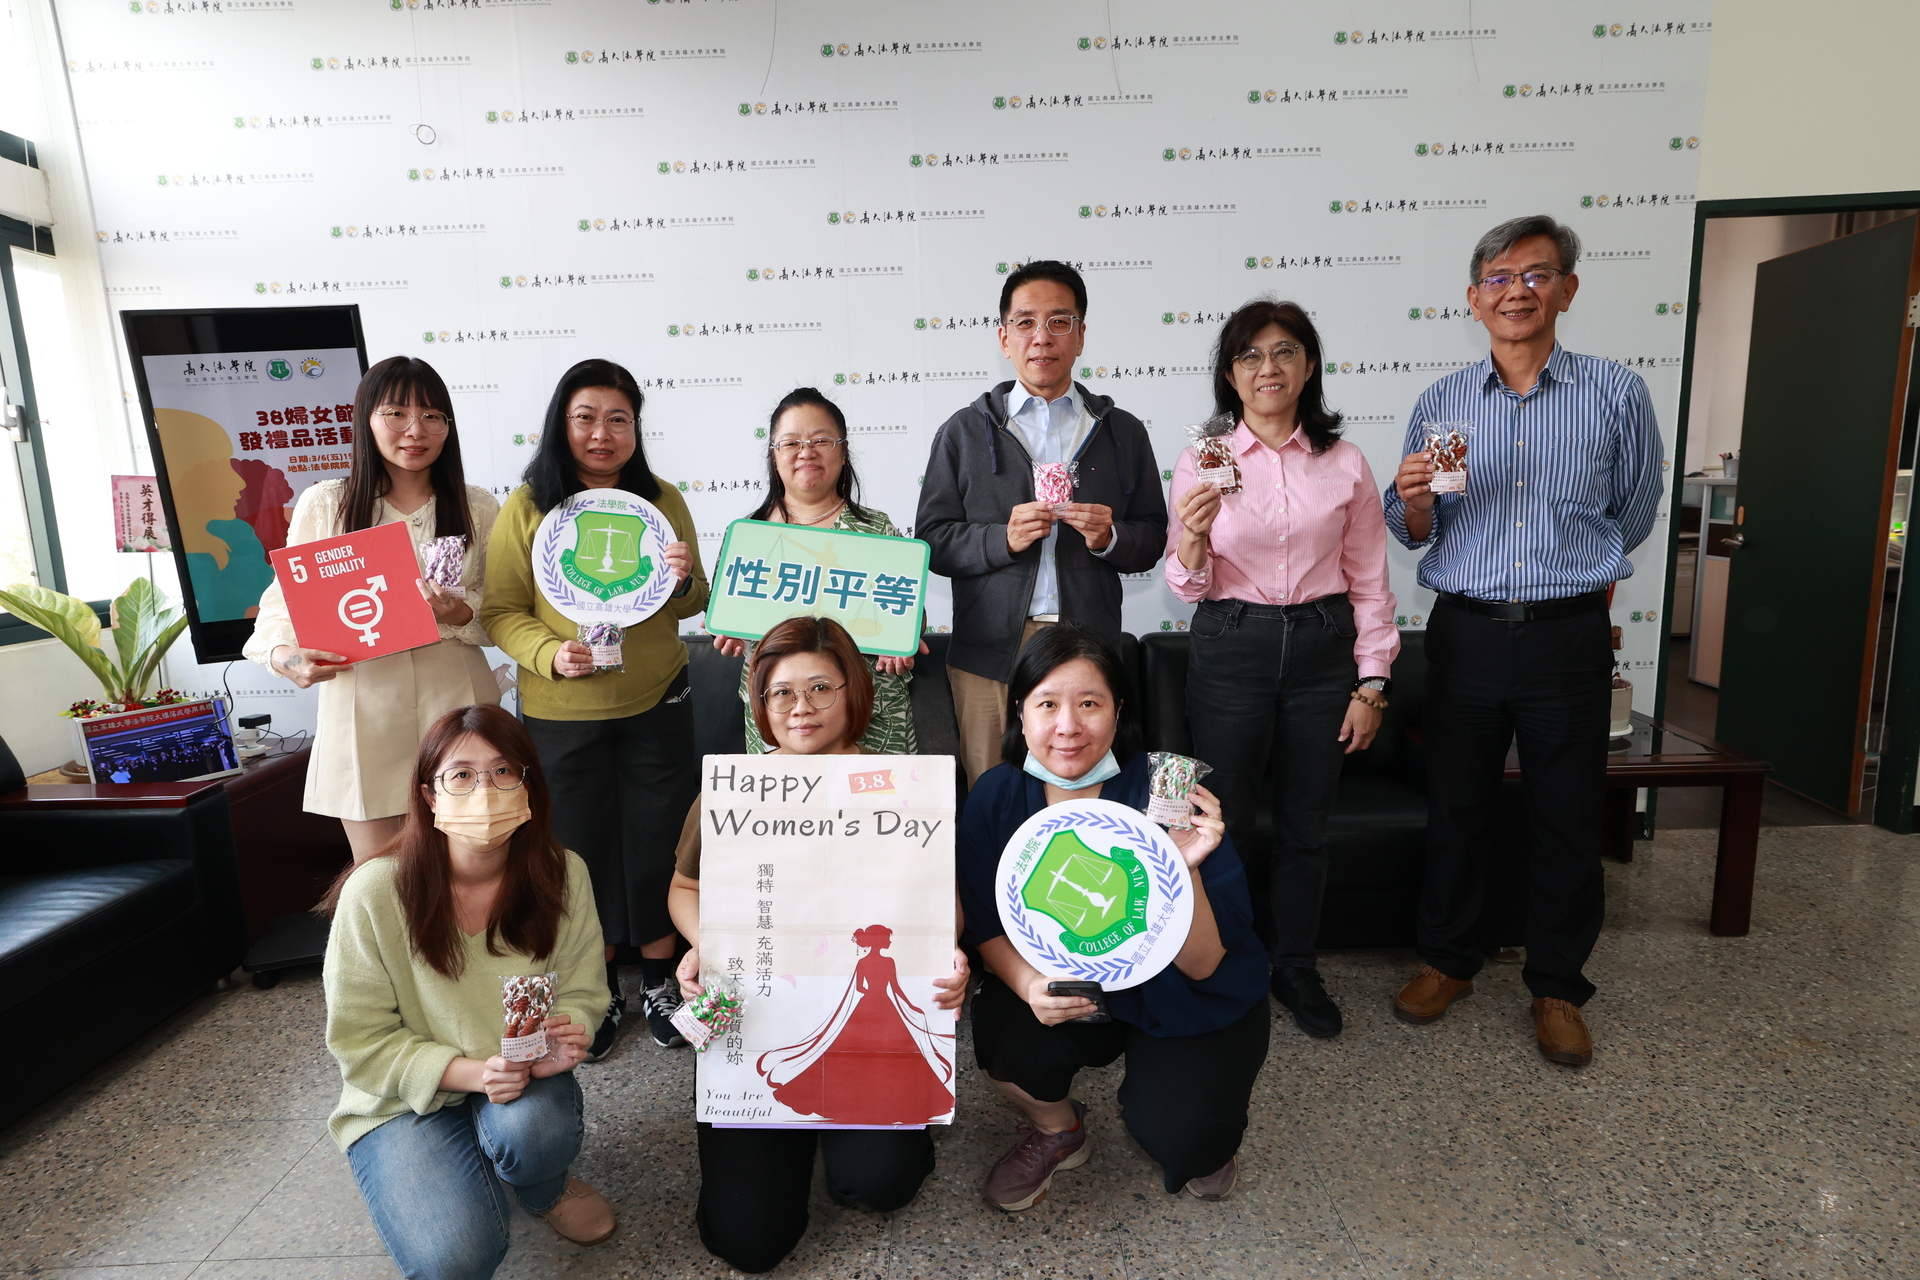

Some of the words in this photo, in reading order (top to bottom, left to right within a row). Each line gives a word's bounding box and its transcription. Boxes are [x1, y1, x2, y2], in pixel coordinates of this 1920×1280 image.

[1194, 311, 1232, 324] 高大法
[288, 462, 351, 472] 地點:法學院院
[596, 498, 628, 511] 法學院
[314, 545, 354, 564] GENDER
[288, 556, 308, 583] 5
[319, 557, 365, 578] EQUALITY
[565, 563, 592, 590] COLLEGE
[594, 585, 604, 596] OF
[608, 584, 628, 597] LAW,
[629, 573, 646, 589] NUK
[725, 555, 918, 616] 性別平等
[576, 600, 632, 613] 國立高雄大學
[710, 764, 822, 803] Happy
[854, 774, 886, 791] 3.8
[710, 808, 861, 837] Women's
[873, 810, 942, 848] Day
[1013, 838, 1042, 876] 法學院
[756, 863, 774, 894] 獨特
[1132, 865, 1145, 887] NUK
[756, 900, 774, 930] 智慧
[1132, 896, 1148, 919] LAW,
[1122, 922, 1135, 937] OF
[1131, 903, 1176, 965] 國立高雄大學
[1078, 931, 1121, 953] COLLEGE
[756, 936, 773, 998] 充滿活力
[705, 1089, 731, 1101] You
[738, 1090, 763, 1101] Are
[704, 1106, 773, 1120] Beautiful
